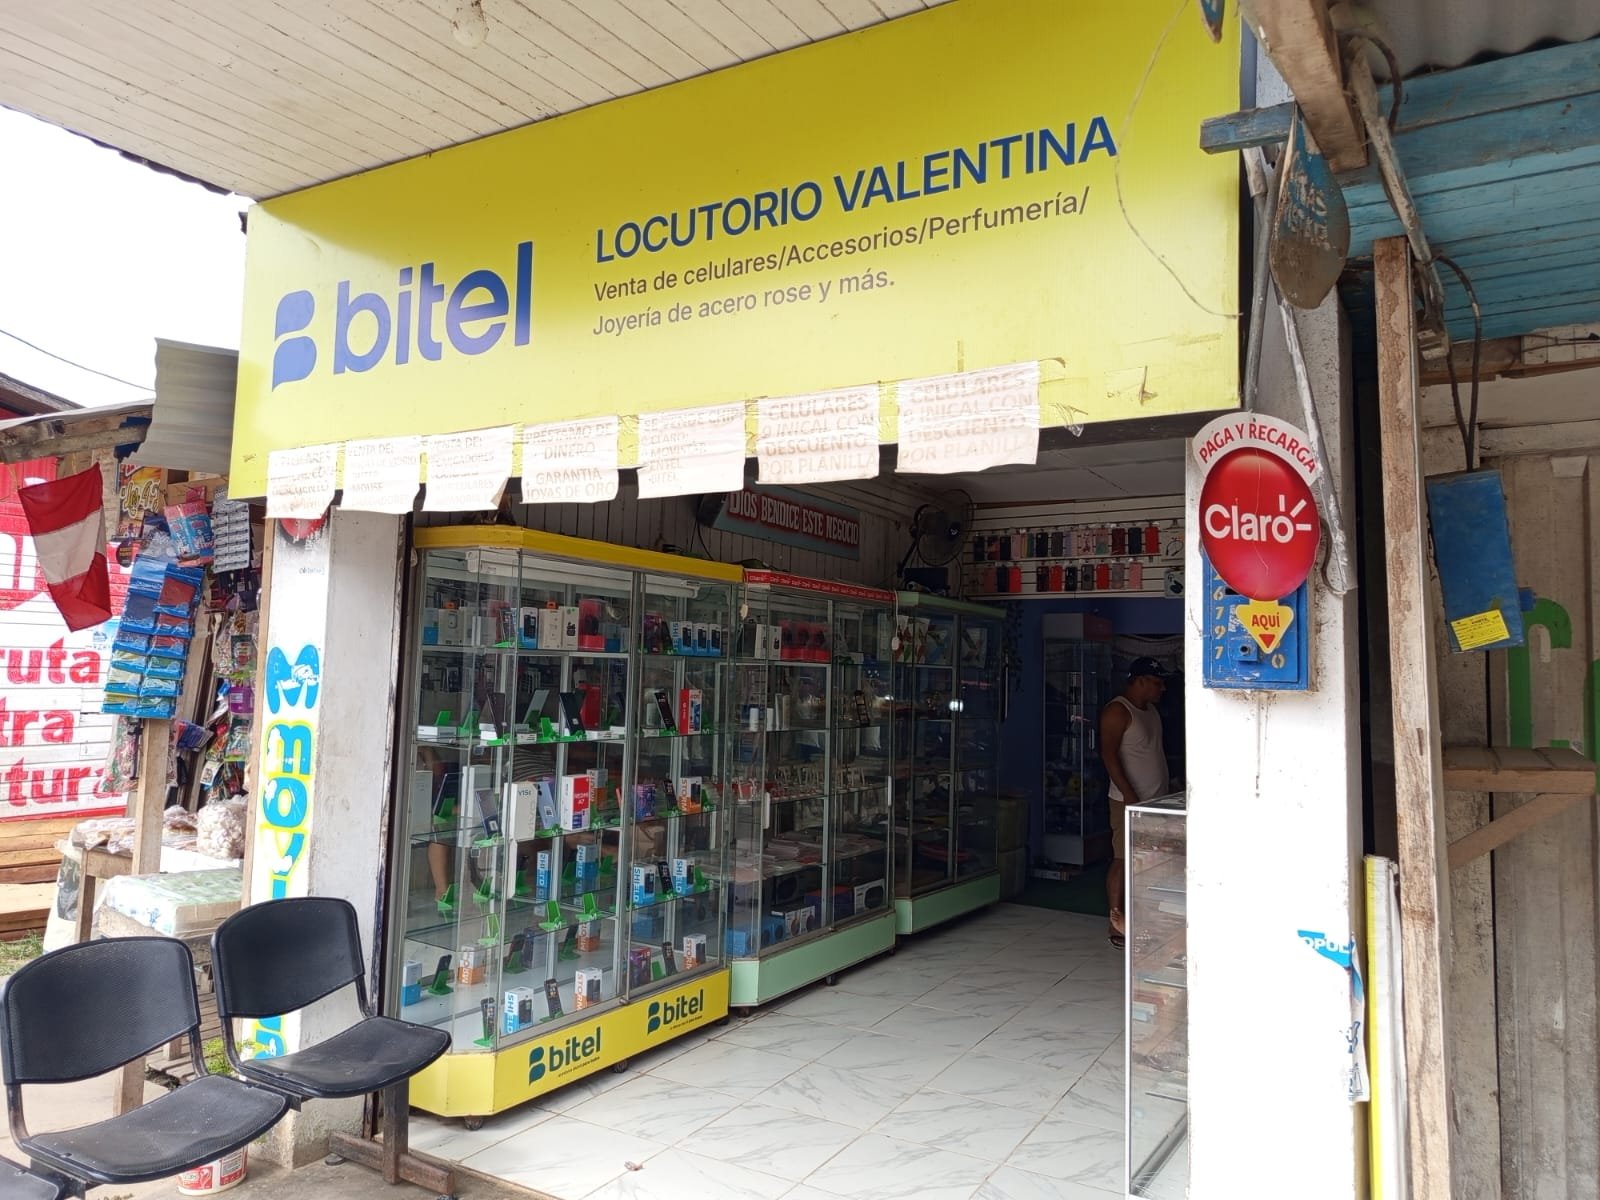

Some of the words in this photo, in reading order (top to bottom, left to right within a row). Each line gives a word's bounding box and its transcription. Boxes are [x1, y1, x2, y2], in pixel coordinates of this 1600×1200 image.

[595, 181, 822, 264] LOCUTORIO
[833, 115, 1118, 213] VALENTINA
[592, 306, 662, 337] Joyería
[667, 302, 693, 323] de
[698, 294, 758, 319] acero
[763, 284, 813, 308] rose
[818, 280, 832, 303] y
[839, 267, 895, 295] más.
[594, 278, 648, 302] Venta
[653, 271, 678, 291] de
[333, 241, 533, 375] bitel
[910, 371, 1026, 403] CELULARES
[989, 393, 1033, 412] CON
[768, 391, 870, 420] CELULARES
[836, 412, 875, 431] CON
[765, 432, 867, 457] DESCUENTO
[909, 415, 1027, 443] DESCUENTO
[543, 441, 597, 460] DINERO
[760, 458, 793, 475] POR
[798, 450, 876, 474] PLANILLA
[900, 447, 937, 464] POR
[1199, 427, 1235, 464] PAGA
[1235, 423, 1245, 439] Y
[1248, 423, 1317, 474] RECARGA
[535, 467, 603, 485] GARANTIA
[584, 481, 616, 497] ORO
[729, 490, 758, 519] DIOS
[760, 495, 801, 531] BENDICE
[802, 508, 824, 537] ESTE
[825, 514, 860, 545] NEGOCIO
[1204, 502, 1295, 544] Claro
[633, 867, 641, 902] SHIELD
[675, 860, 683, 893] SHIELD
[507, 992, 515, 1033] SHIELD
[663, 989, 704, 1025] bitel
[550, 1026, 602, 1073] bitel
